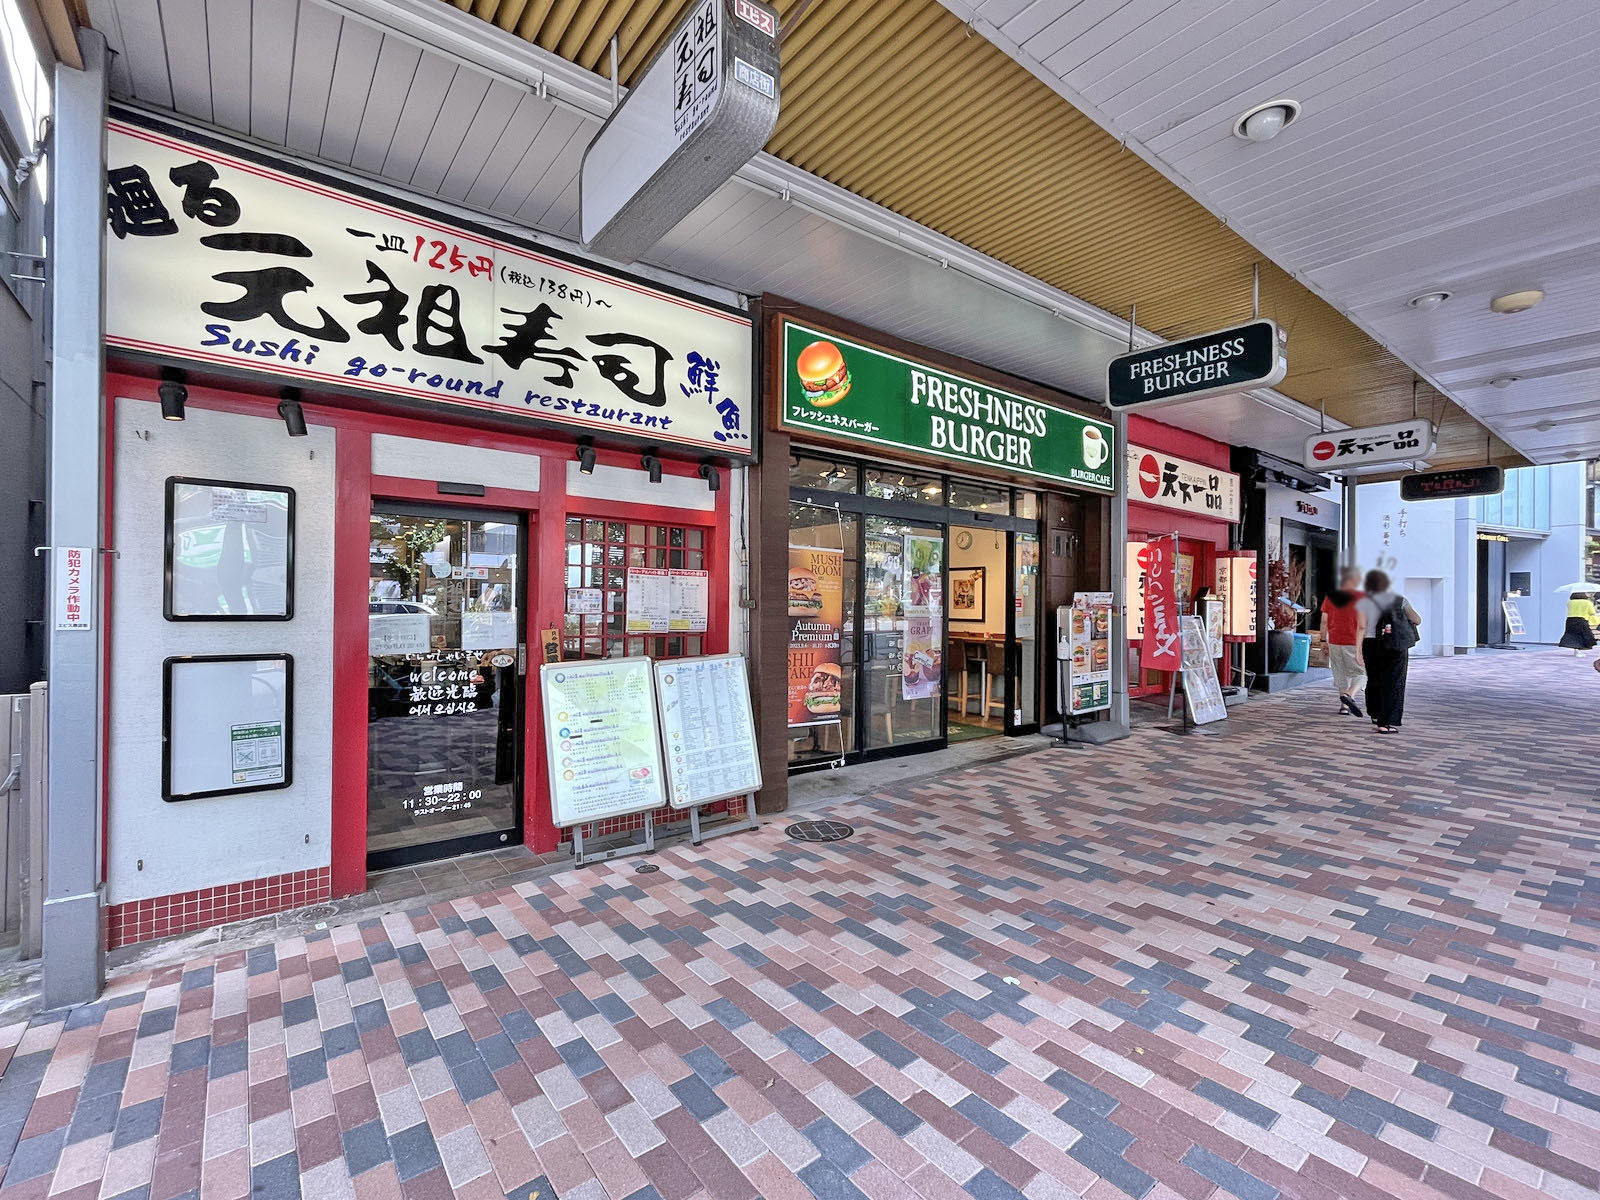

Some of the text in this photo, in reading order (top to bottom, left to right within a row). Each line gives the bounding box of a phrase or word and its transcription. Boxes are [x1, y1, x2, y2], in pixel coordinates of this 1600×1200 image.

[739, 2, 771, 33] エビス
[739, 64, 770, 93] 商店街
[199, 232, 675, 407] 元祖寿司
[1129, 337, 1246, 380] FRESHNESS
[200, 323, 674, 431] Sushi go-round restaurant
[1143, 361, 1230, 395] BURGER
[680, 351, 748, 442] 鮮魚
[910, 369, 1047, 438] FRESHNESS
[792, 405, 880, 433] フレッシュネスバーガー
[930, 416, 1033, 469] BURGER
[1337, 429, 1419, 457] 天下一品
[1161, 461, 1222, 510] 天下一品
[811, 553, 842, 566] MUSH
[811, 564, 842, 577] ROOM
[67, 550, 81, 621] 防犯カメラ作動中
[791, 630, 833, 641] Premium
[795, 620, 831, 631] Autumn
[405, 649, 484, 662] いらっしゃいませ
[409, 666, 478, 683] welcome
[409, 704, 431, 717] 어서
[423, 781, 463, 797] 営業時間
